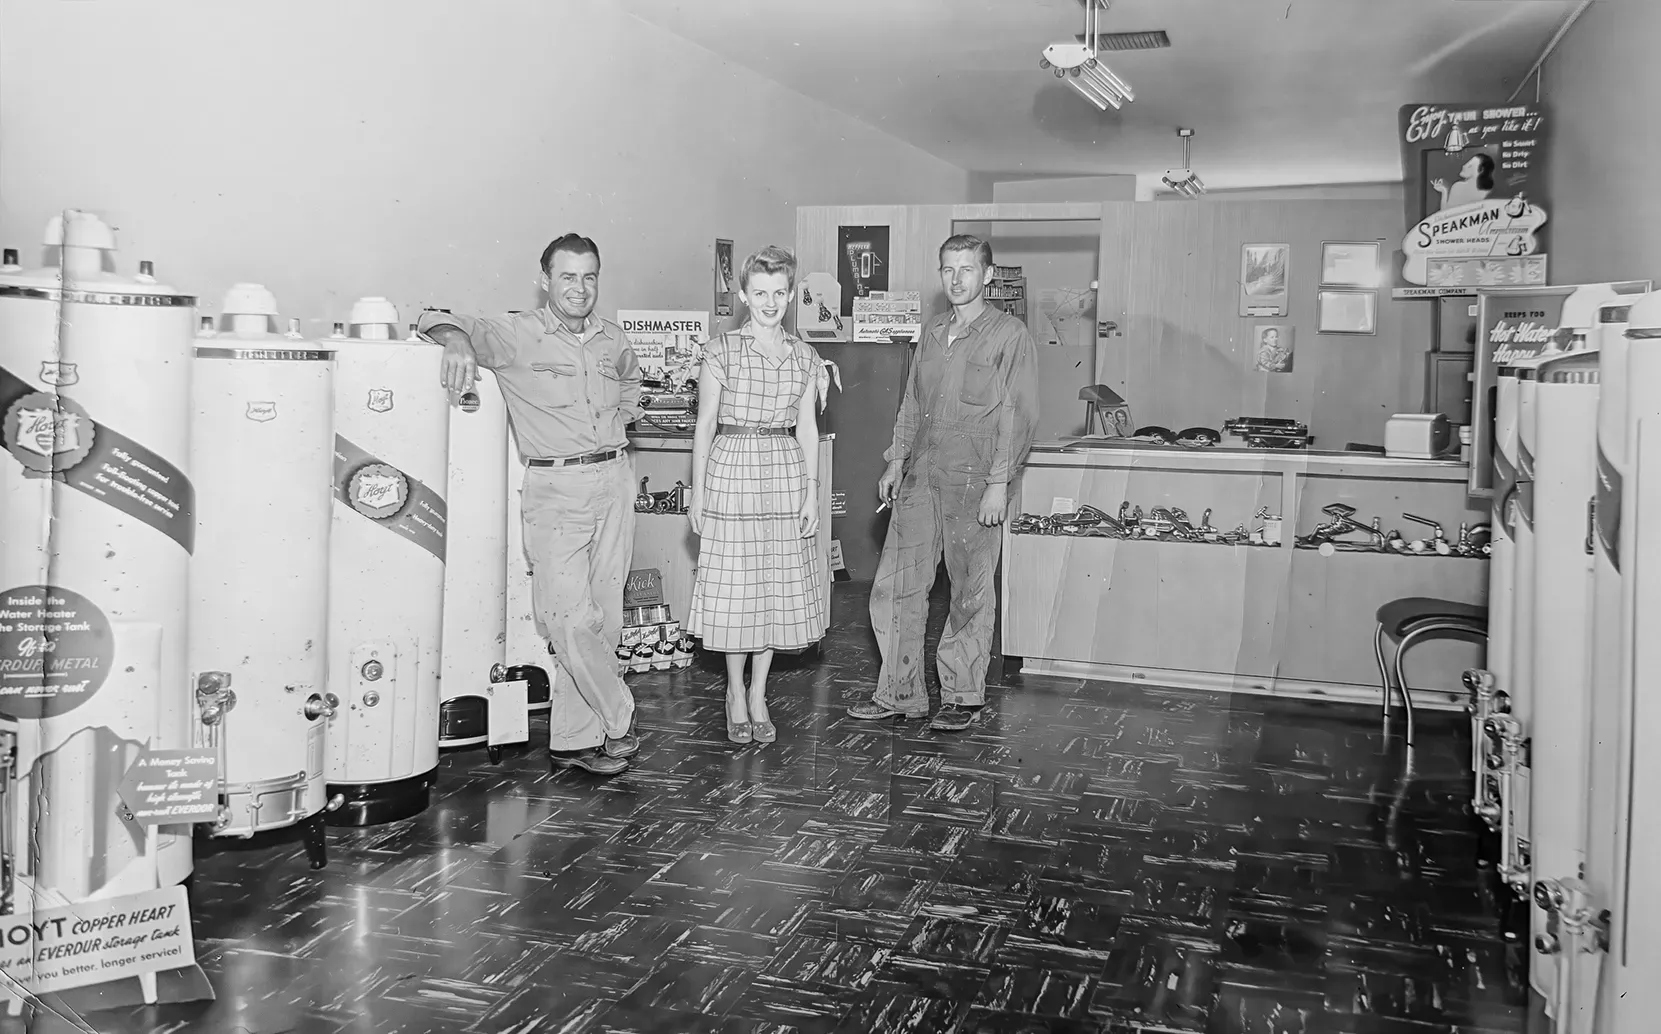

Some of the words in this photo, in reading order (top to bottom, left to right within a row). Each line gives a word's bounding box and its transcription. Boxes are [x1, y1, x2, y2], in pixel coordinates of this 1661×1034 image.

[1406, 106, 1447, 142] Enjoy
[1501, 120, 1519, 131] like
[1521, 117, 1541, 131] it!
[1417, 208, 1500, 248] SPEAKMAN
[623, 320, 702, 331] DISHMASTER
[879, 327, 893, 336] GAS
[1489, 320, 1516, 343] Hot
[363, 483, 394, 501] Hoyt
[627, 573, 655, 592] Kick
[8, 596, 42, 606] Inside
[47, 596, 66, 605] the
[37, 608, 76, 619] Heater
[17, 622, 62, 633] Storage
[63, 620, 91, 631] Tank
[51, 656, 99, 670] METAL
[138, 758, 147, 767] A
[149, 757, 182, 767] Money
[184, 755, 215, 765] Saving
[165, 768, 188, 778] Tank
[71, 912, 126, 935] COPPER
[128, 903, 176, 926] HEART
[37, 937, 102, 962] EVERDUR
[102, 934, 148, 950] storage
[150, 924, 181, 941] tank
[101, 957, 136, 969] longer
